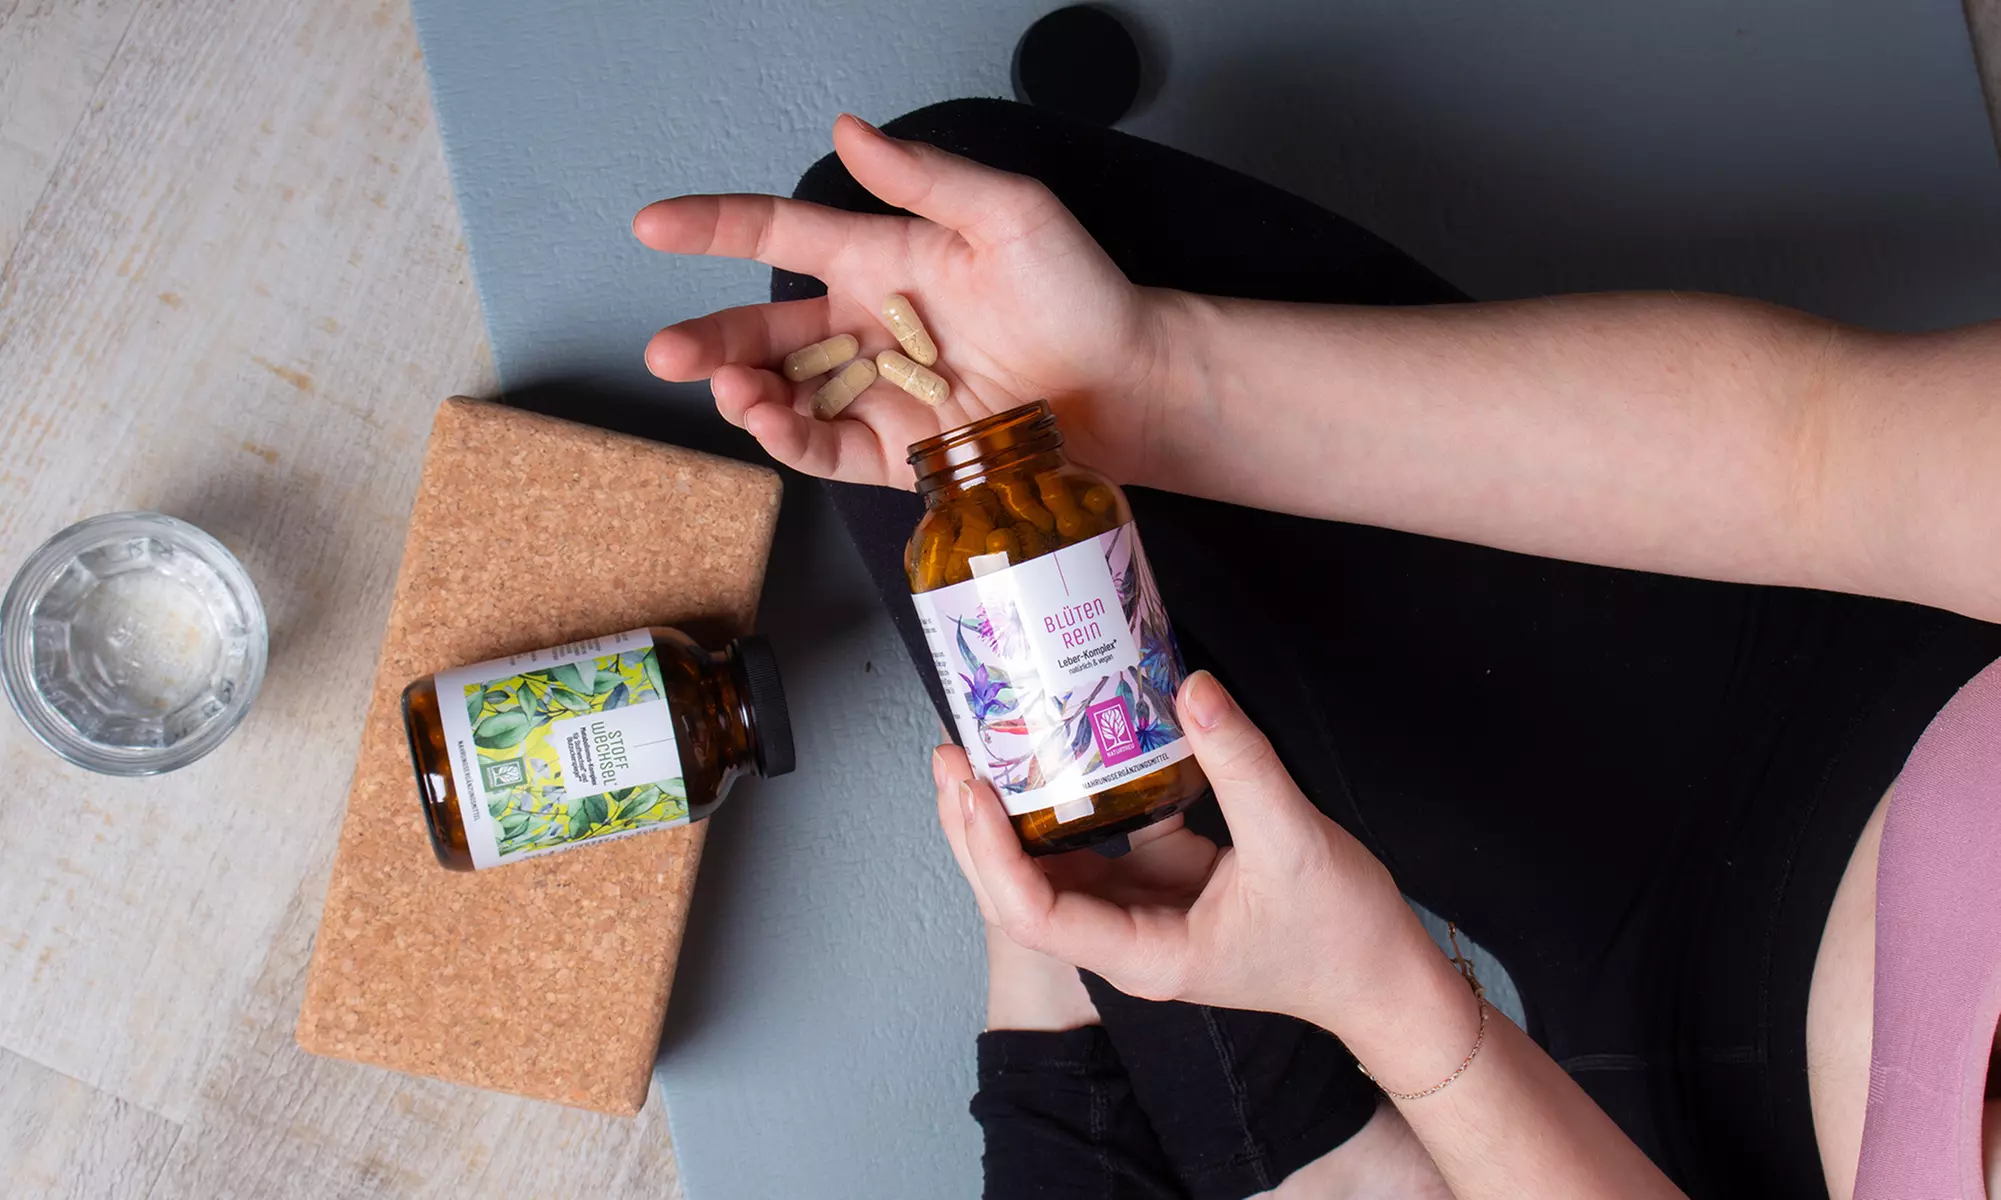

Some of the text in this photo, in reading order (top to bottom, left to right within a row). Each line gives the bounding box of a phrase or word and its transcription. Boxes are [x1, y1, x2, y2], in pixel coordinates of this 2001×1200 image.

[1068, 653, 1114, 675] natürlich & vegan
[608, 730, 629, 769] STOFF
